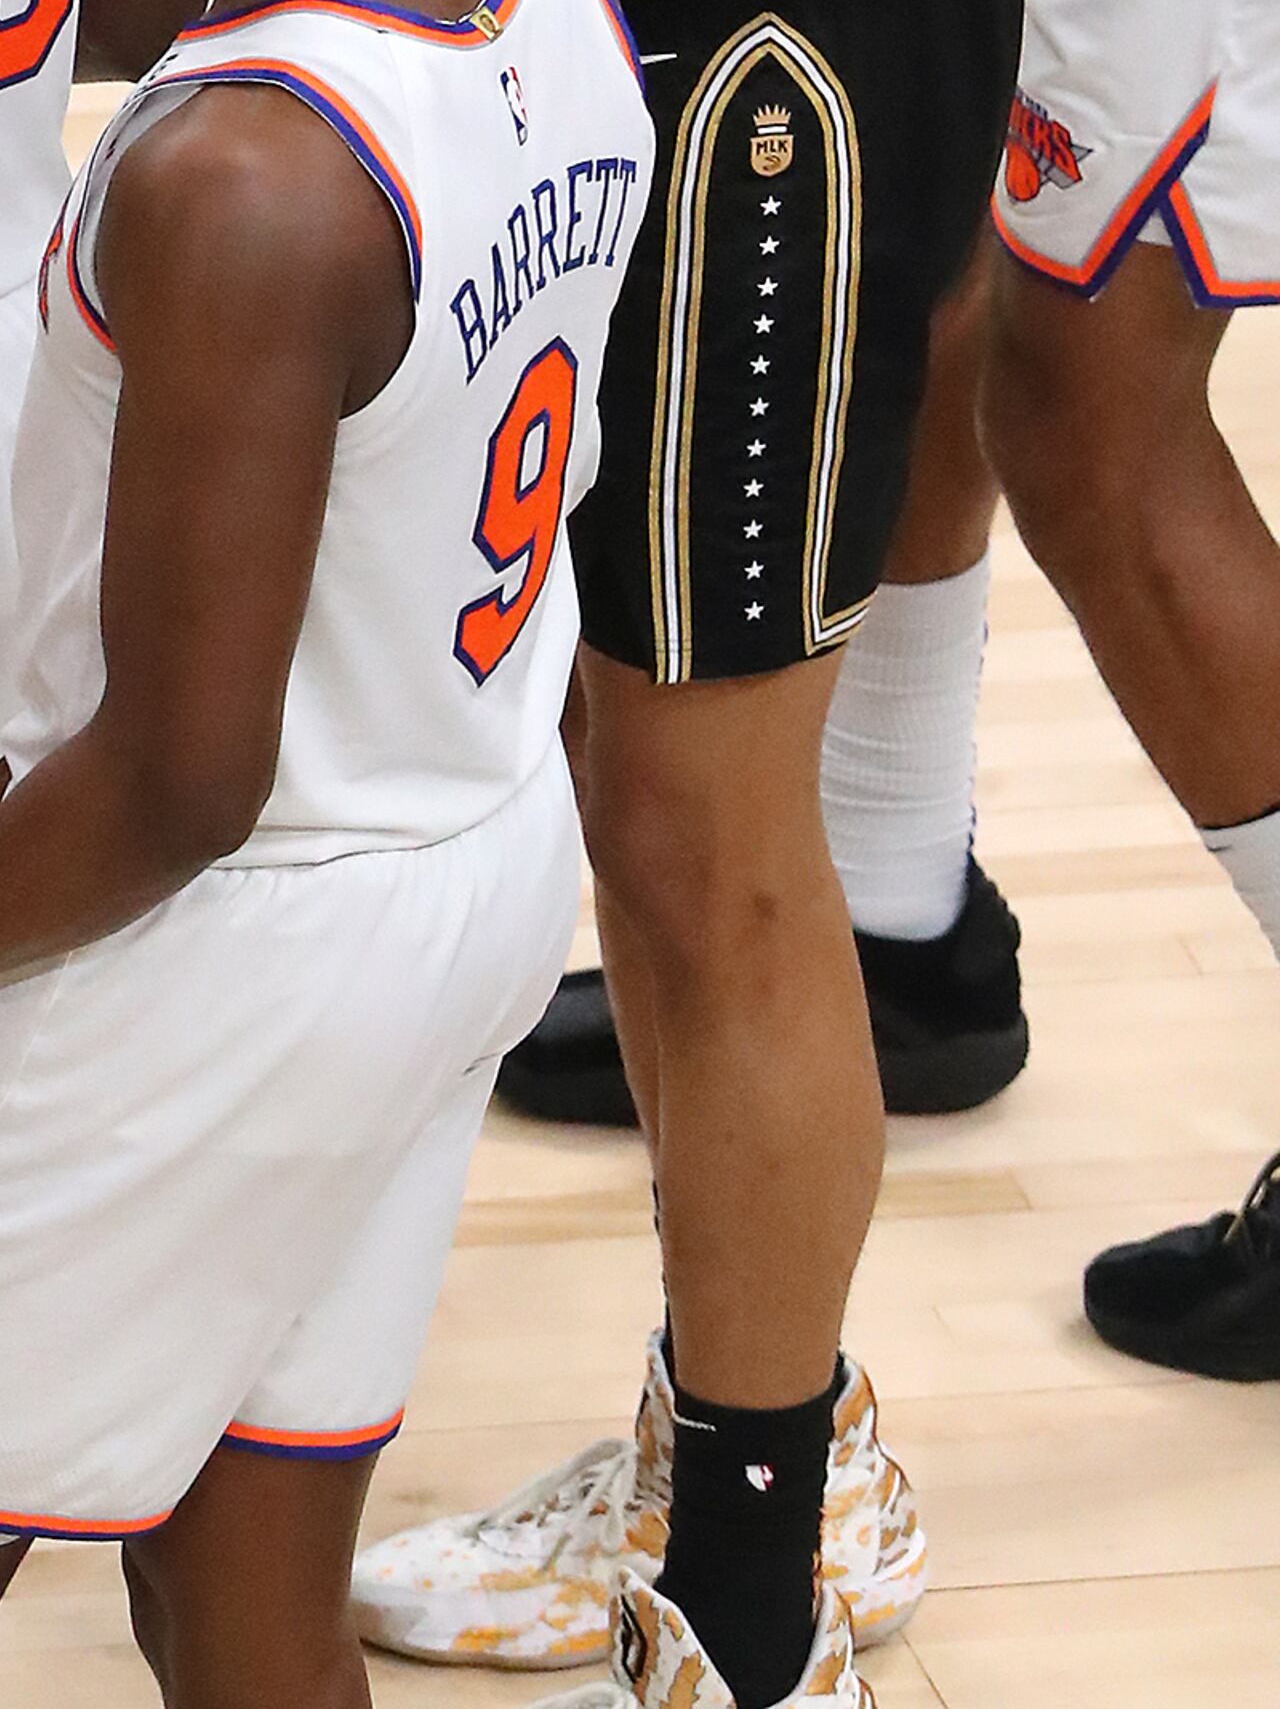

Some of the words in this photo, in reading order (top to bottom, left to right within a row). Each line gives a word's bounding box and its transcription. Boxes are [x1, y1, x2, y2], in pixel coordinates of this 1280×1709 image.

[755, 138, 788, 156] MLK
[450, 157, 636, 386] BARRETT
[453, 336, 578, 687] 9
